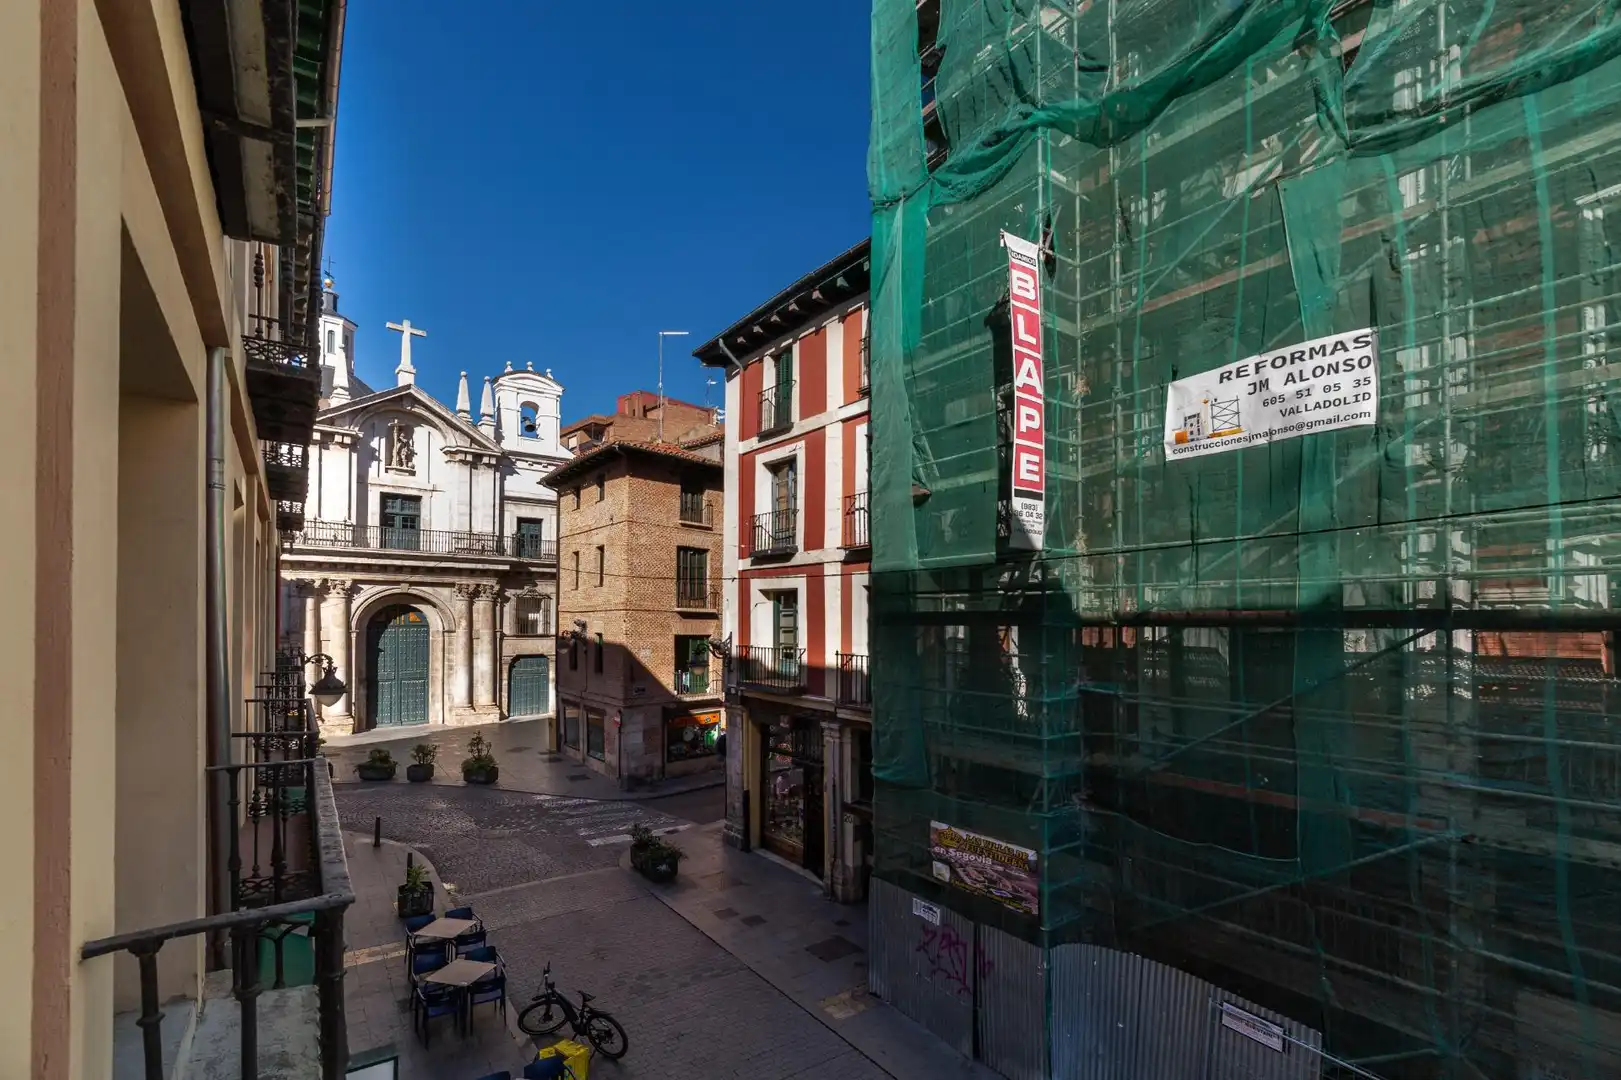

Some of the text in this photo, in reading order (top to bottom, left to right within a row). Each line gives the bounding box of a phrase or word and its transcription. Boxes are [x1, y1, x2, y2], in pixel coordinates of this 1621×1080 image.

[1012, 268, 1044, 483] BLAPE
[1219, 334, 1372, 384] REFORMAS
[1247, 354, 1372, 396] JM ALONSO
[1262, 376, 1372, 408] 605 51 05 35
[1279, 391, 1372, 418] VALLADOLID
[1172, 411, 1371, 455] construccionesjmalonso@gmail.com
[934, 845, 992, 865] en Segovia
